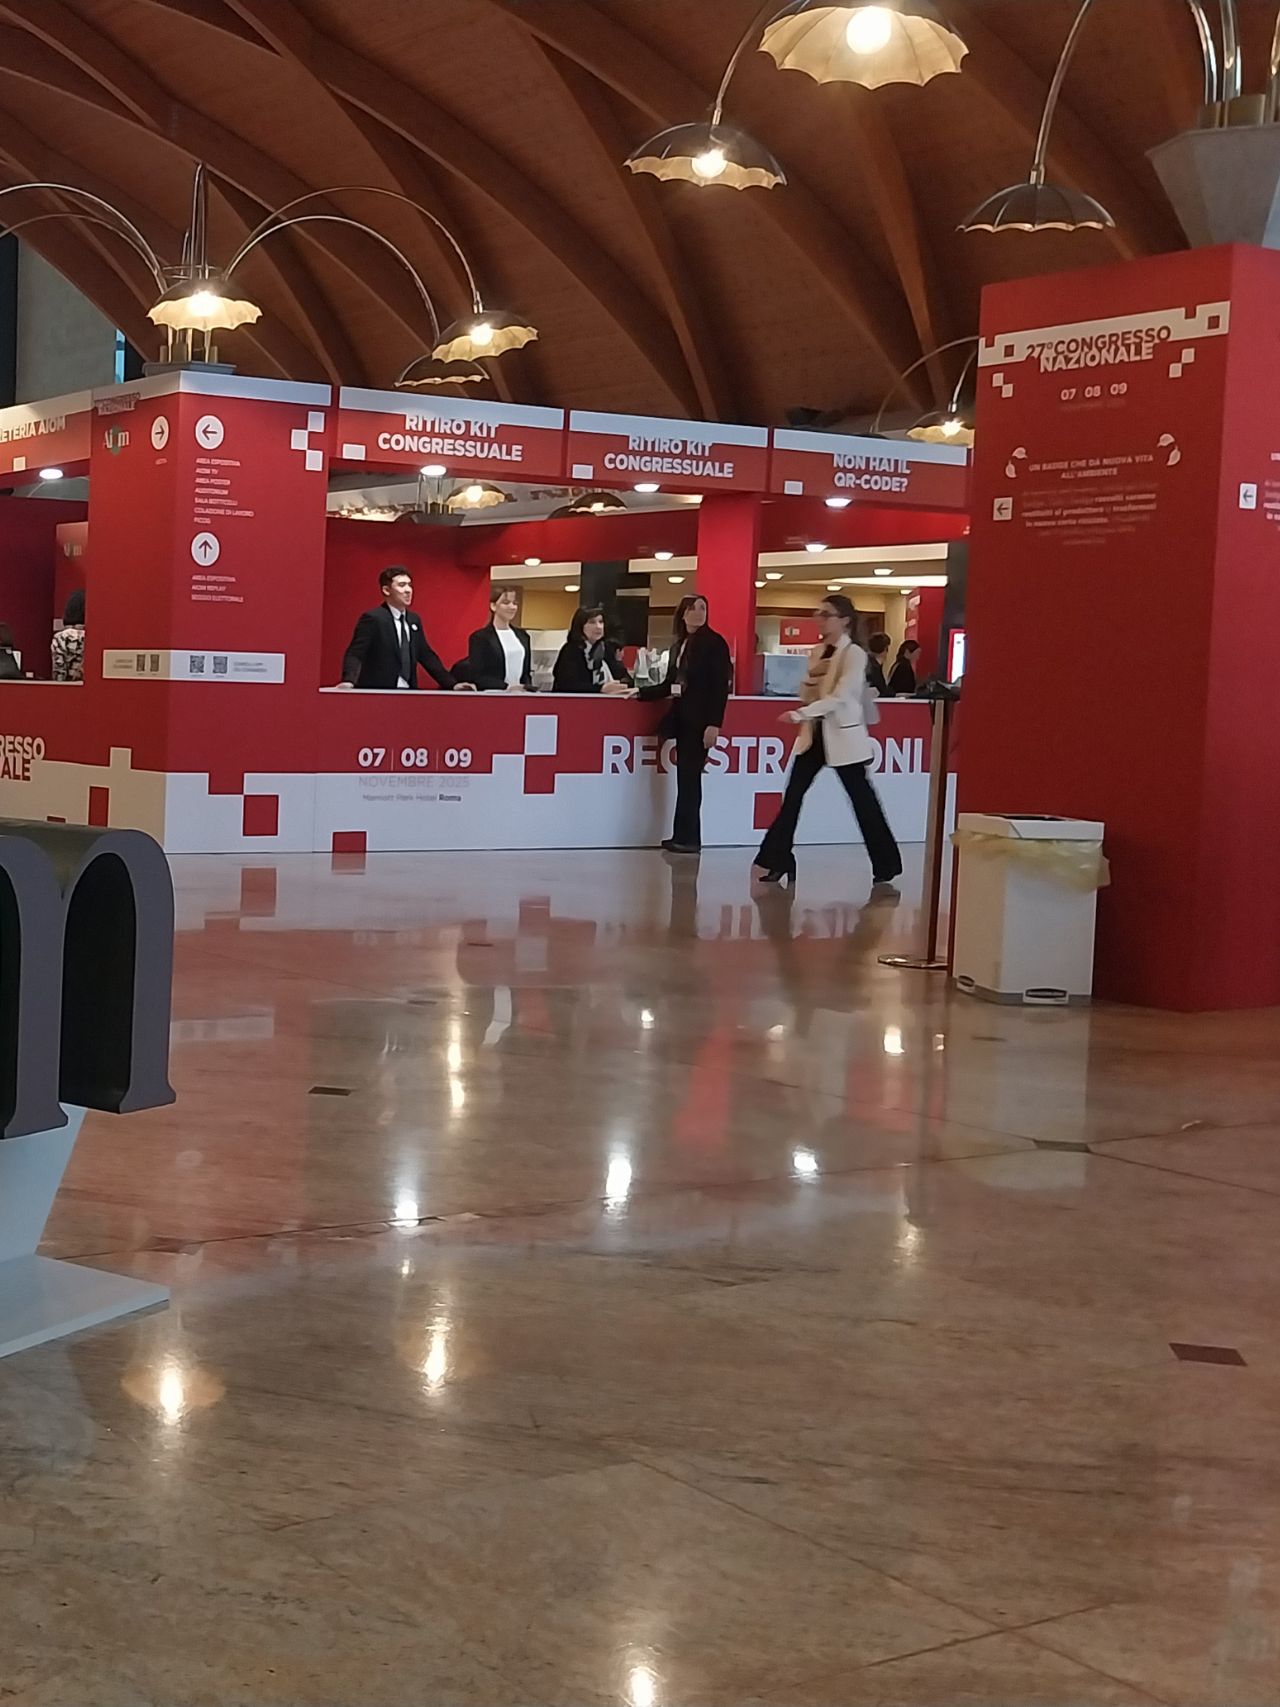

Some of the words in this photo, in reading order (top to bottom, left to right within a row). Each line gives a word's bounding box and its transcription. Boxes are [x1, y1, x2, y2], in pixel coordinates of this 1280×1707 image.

[1040, 342, 1153, 373] NAZIONALE
[1061, 388, 1076, 401] 07
[1085, 386, 1101, 398] 08
[1110, 382, 1128, 395] 09
[37, 416, 66, 435] AIOM
[405, 415, 466, 436] RITIRO
[470, 421, 500, 439] KIT
[377, 432, 524, 462] CONGRESSUALE
[628, 434, 683, 455] RITIRO
[686, 440, 713, 457] KIT
[604, 452, 734, 479] CONGRESSUALE
[833, 453, 866, 470] NON
[869, 457, 895, 473] HAI
[897, 459, 911, 474] IL
[834, 472, 909, 493] QR-CODE?
[358, 747, 386, 768] 07
[401, 747, 428, 768] 08
[444, 747, 472, 769] 09
[358, 775, 434, 788] NOVEMBRE
